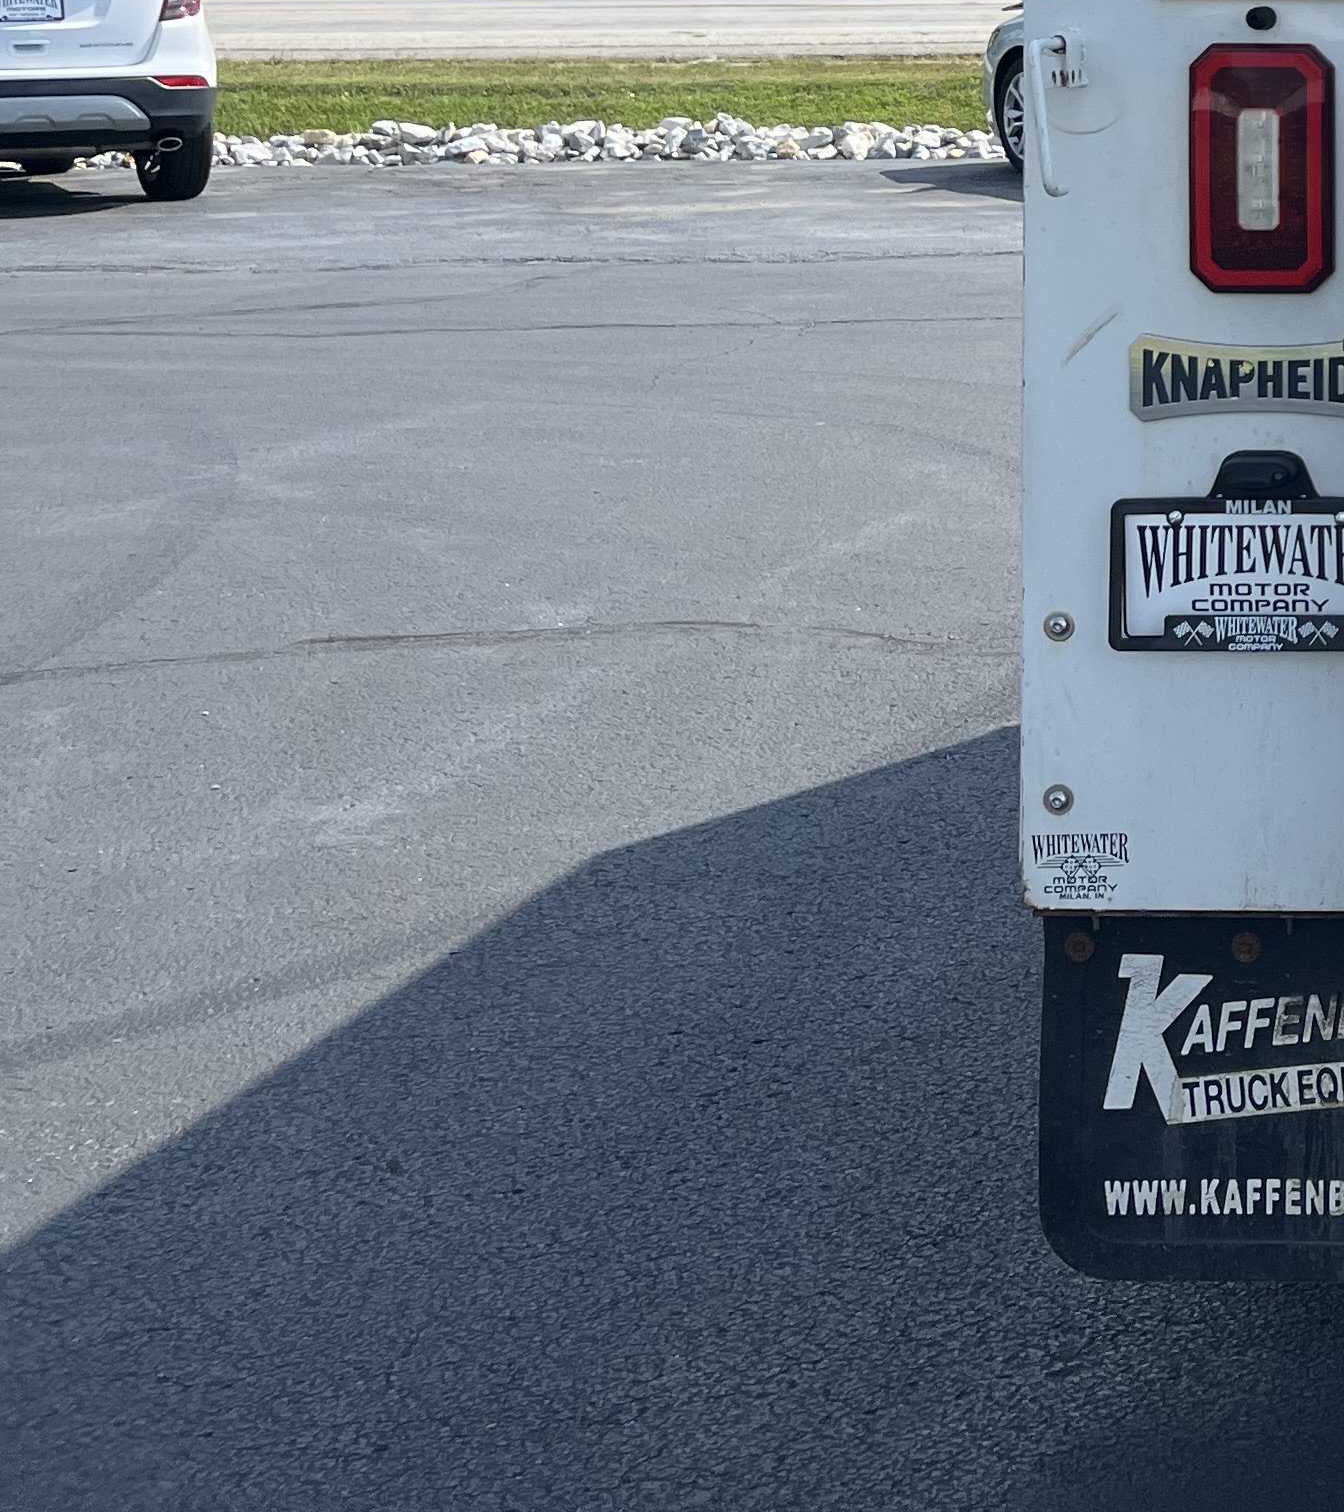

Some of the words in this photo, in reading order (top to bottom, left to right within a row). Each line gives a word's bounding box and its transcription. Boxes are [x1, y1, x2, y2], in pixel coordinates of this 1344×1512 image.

[1226, 500, 1292, 514] MILAN
[1209, 583, 1310, 596] MOTOR
[1191, 599, 1330, 612] COMPANY
[1214, 616, 1298, 644] WHITEWATER
[1228, 643, 1283, 651] COMPANY
[1031, 833, 1129, 864] WHITEWATER
[1053, 876, 1107, 884] MOTOR
[1044, 884, 1118, 894] COMPANY
[1183, 1071, 1290, 1117] TRUCK
